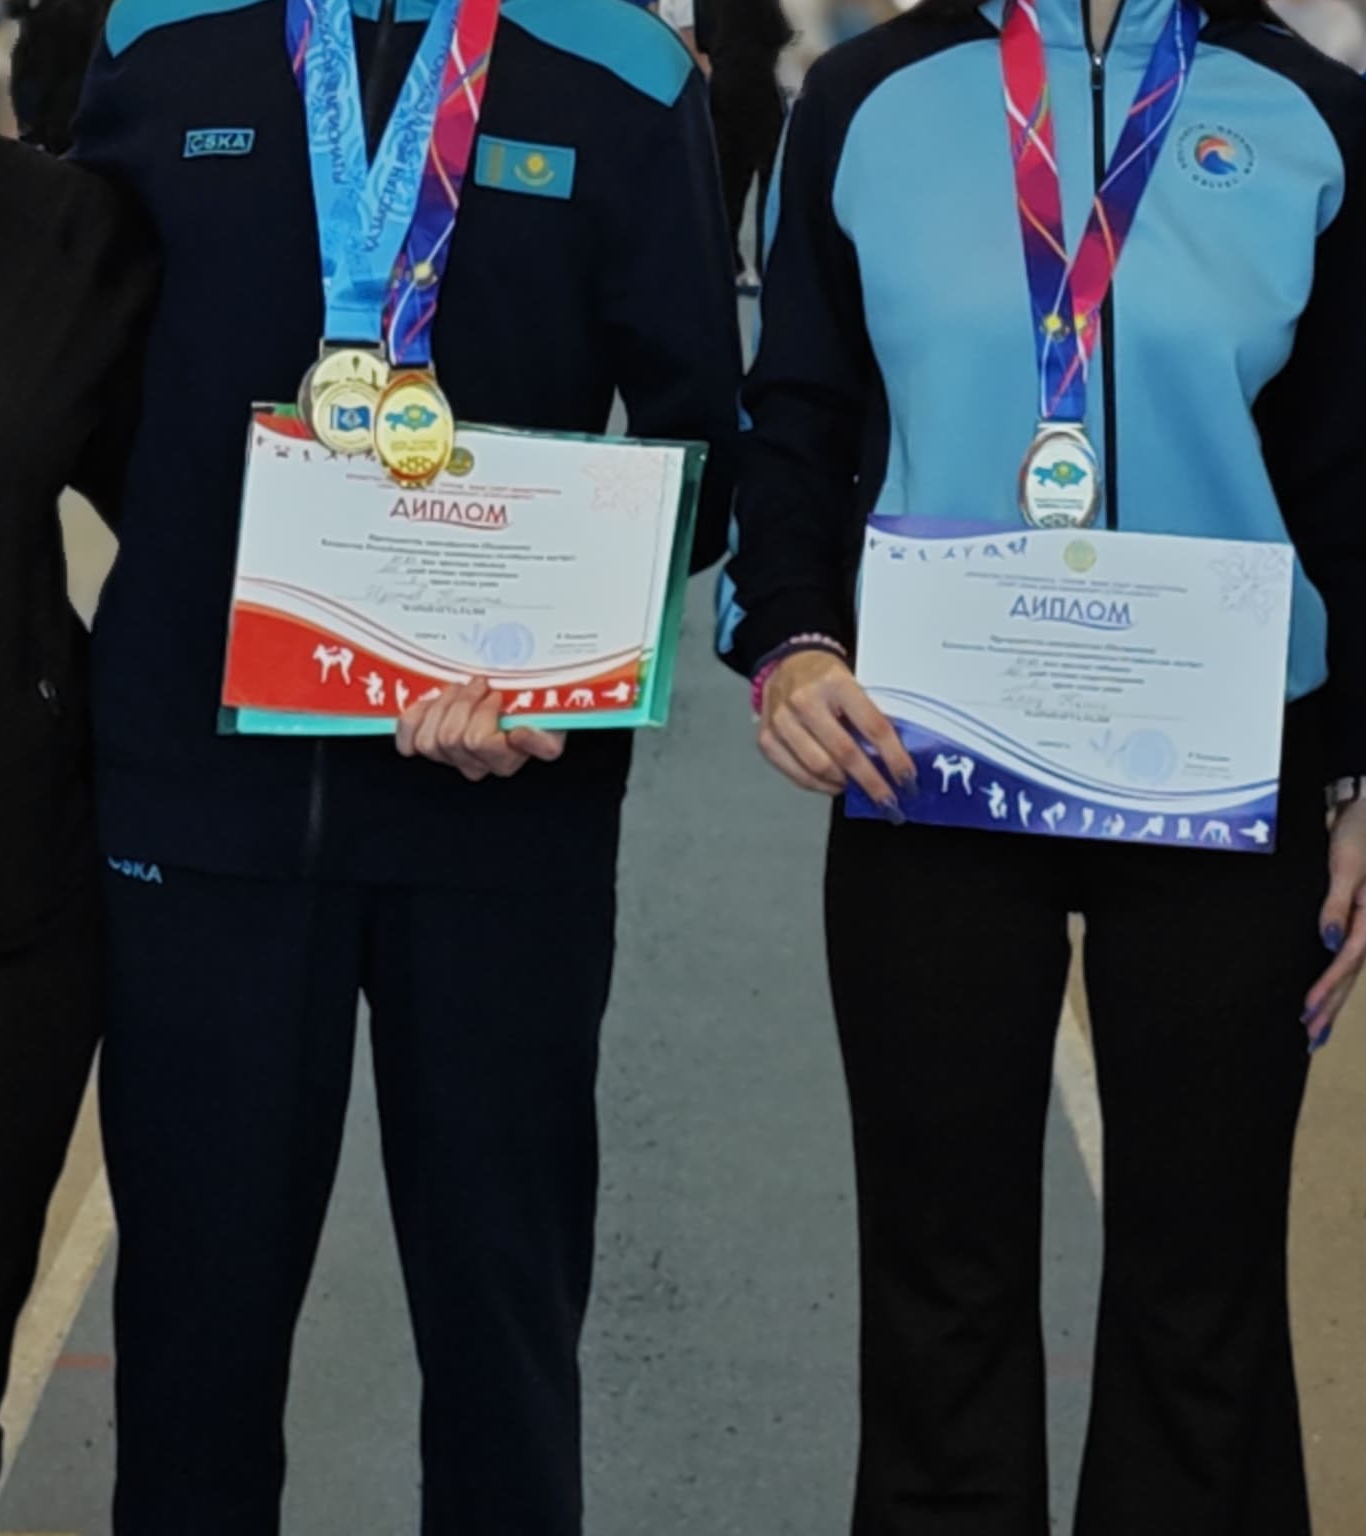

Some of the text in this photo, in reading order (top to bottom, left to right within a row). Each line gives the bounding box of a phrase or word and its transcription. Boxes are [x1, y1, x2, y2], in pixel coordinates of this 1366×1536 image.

[189, 133, 247, 152] CSKA
[389, 496, 508, 525] ДИПЛОМ
[1009, 595, 1132, 626] ДИПЛОМ
